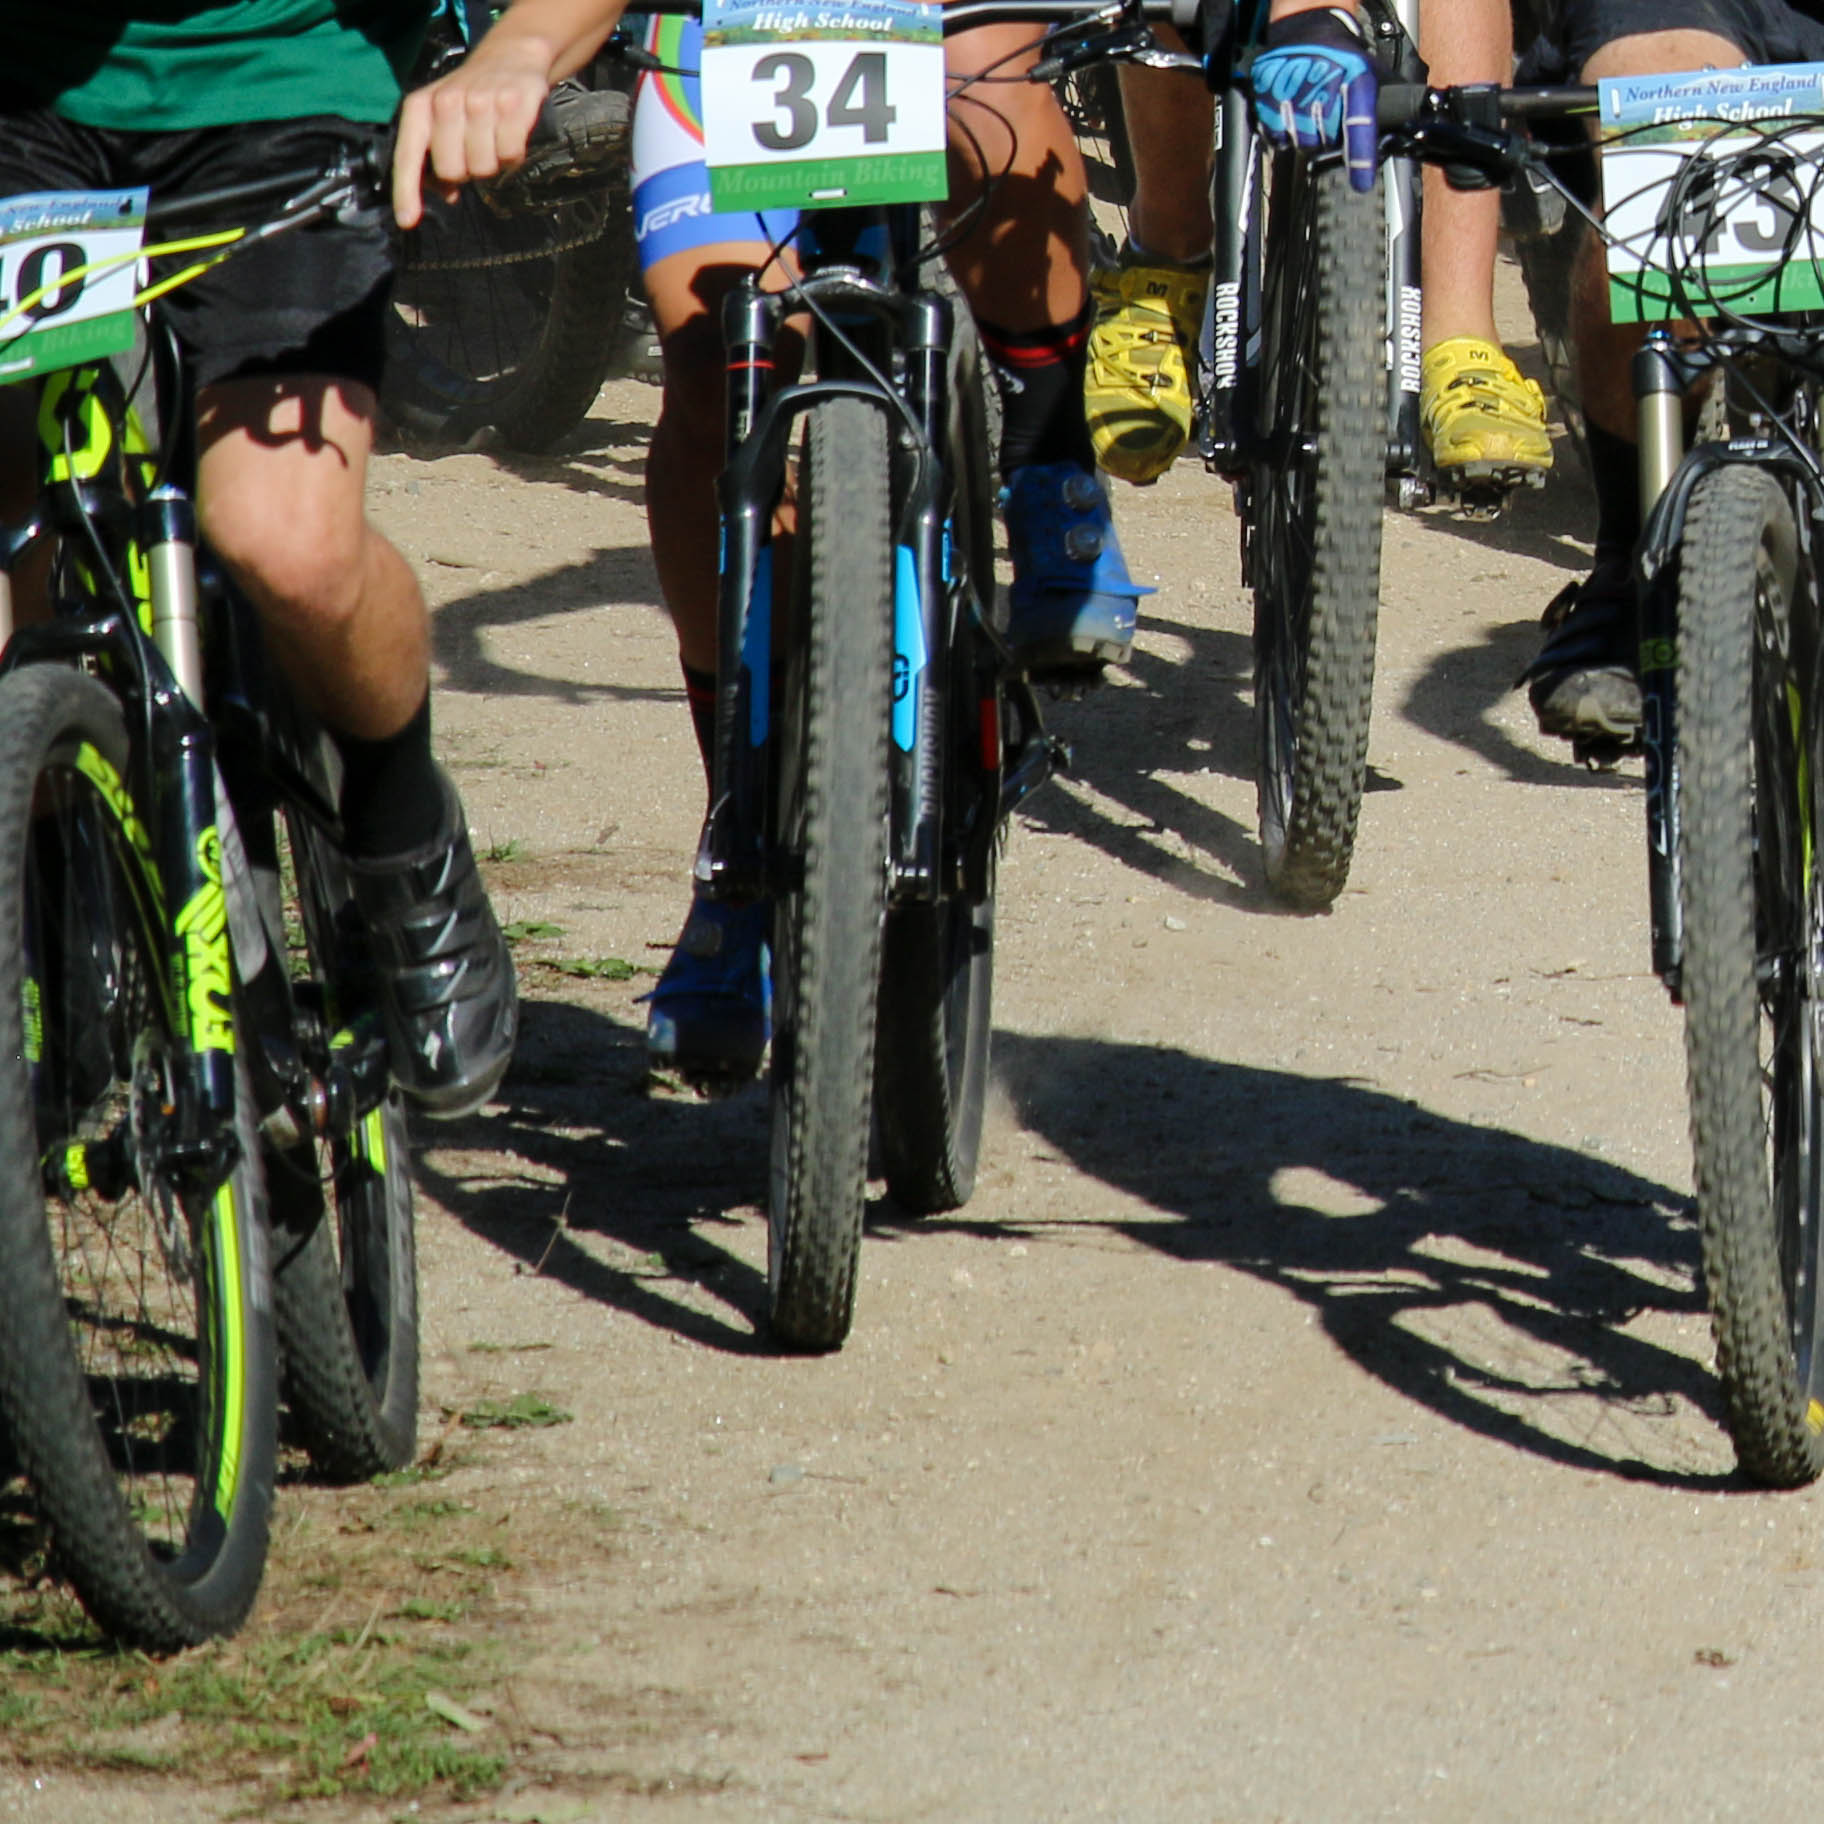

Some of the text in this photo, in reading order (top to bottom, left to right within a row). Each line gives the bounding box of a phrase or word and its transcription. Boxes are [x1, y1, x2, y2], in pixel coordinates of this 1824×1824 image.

[751, 10, 892, 33] High School
[750, 52, 896, 150] 34
[1625, 81, 1698, 104] Northern
[1743, 72, 1819, 95] England
[0, 240, 87, 324] 0
[1215, 281, 1240, 391] ROCKSHOX
[1400, 285, 1423, 394] ROCKSHOX
